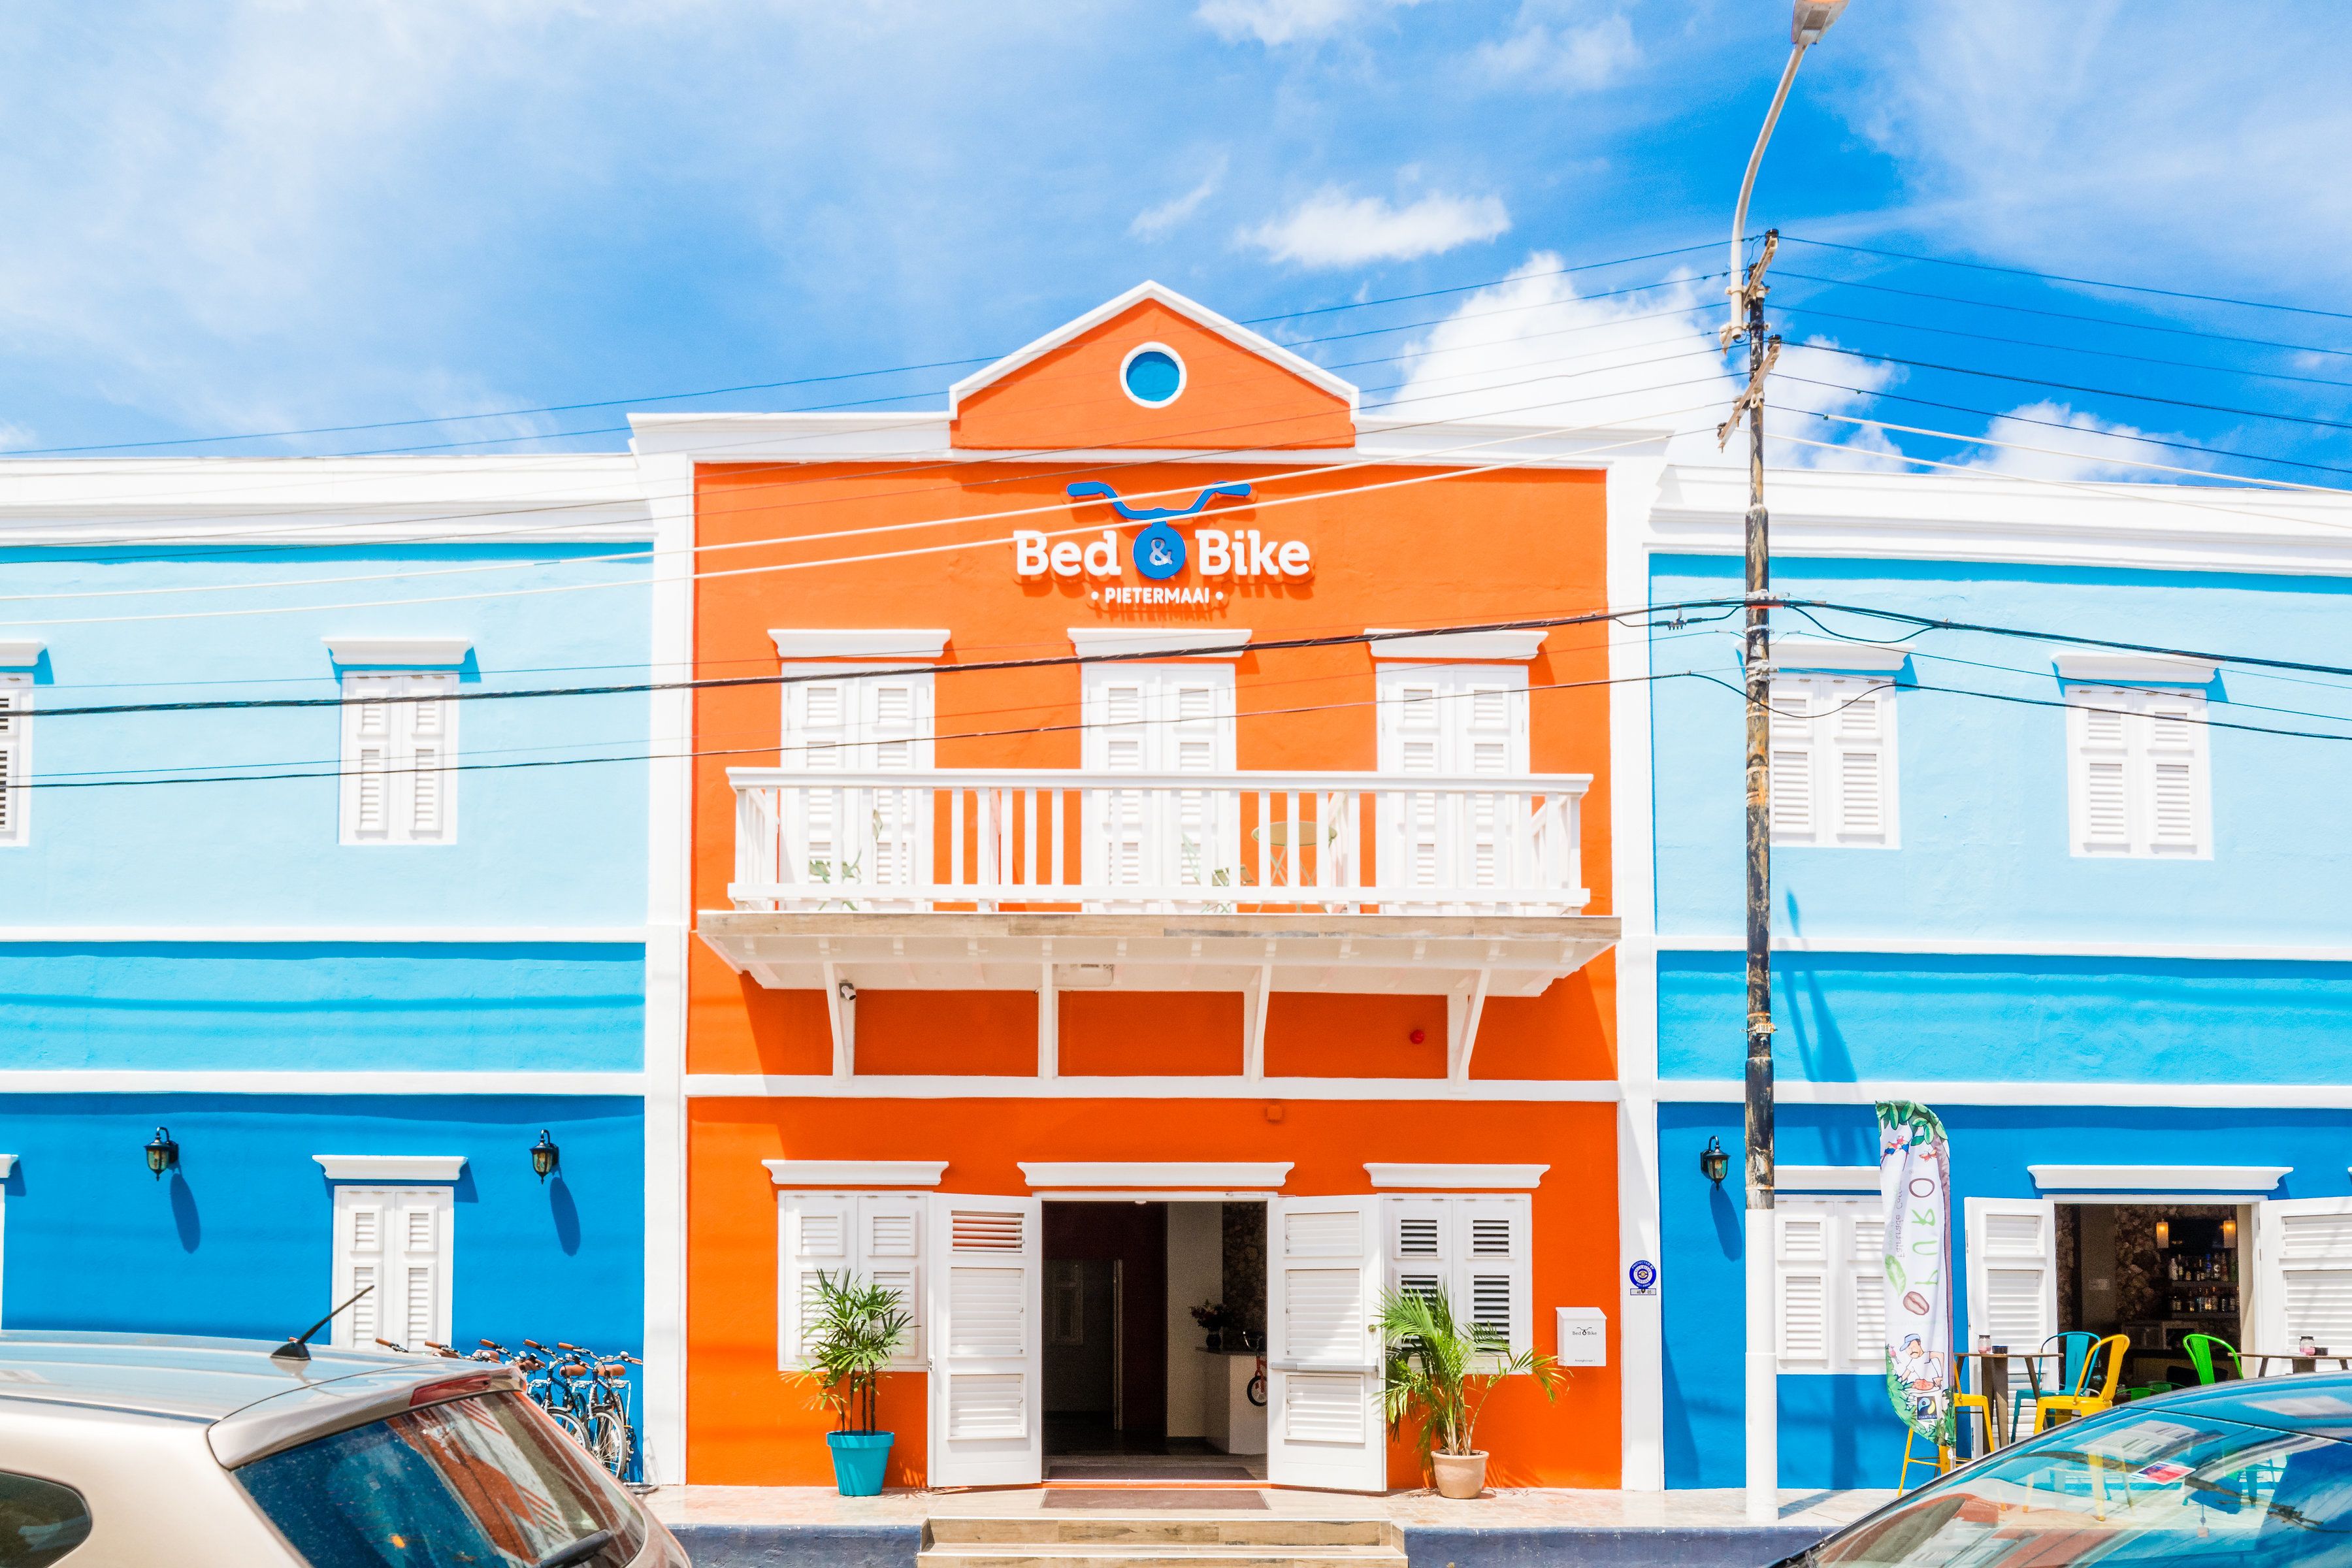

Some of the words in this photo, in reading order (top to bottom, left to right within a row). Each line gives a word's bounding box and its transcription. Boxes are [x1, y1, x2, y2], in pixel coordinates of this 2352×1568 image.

[1013, 530, 1121, 576] Bed
[1149, 538, 1173, 566] &
[1195, 529, 1311, 576] Bike
[1105, 587, 1210, 604] PIETERMAAI
